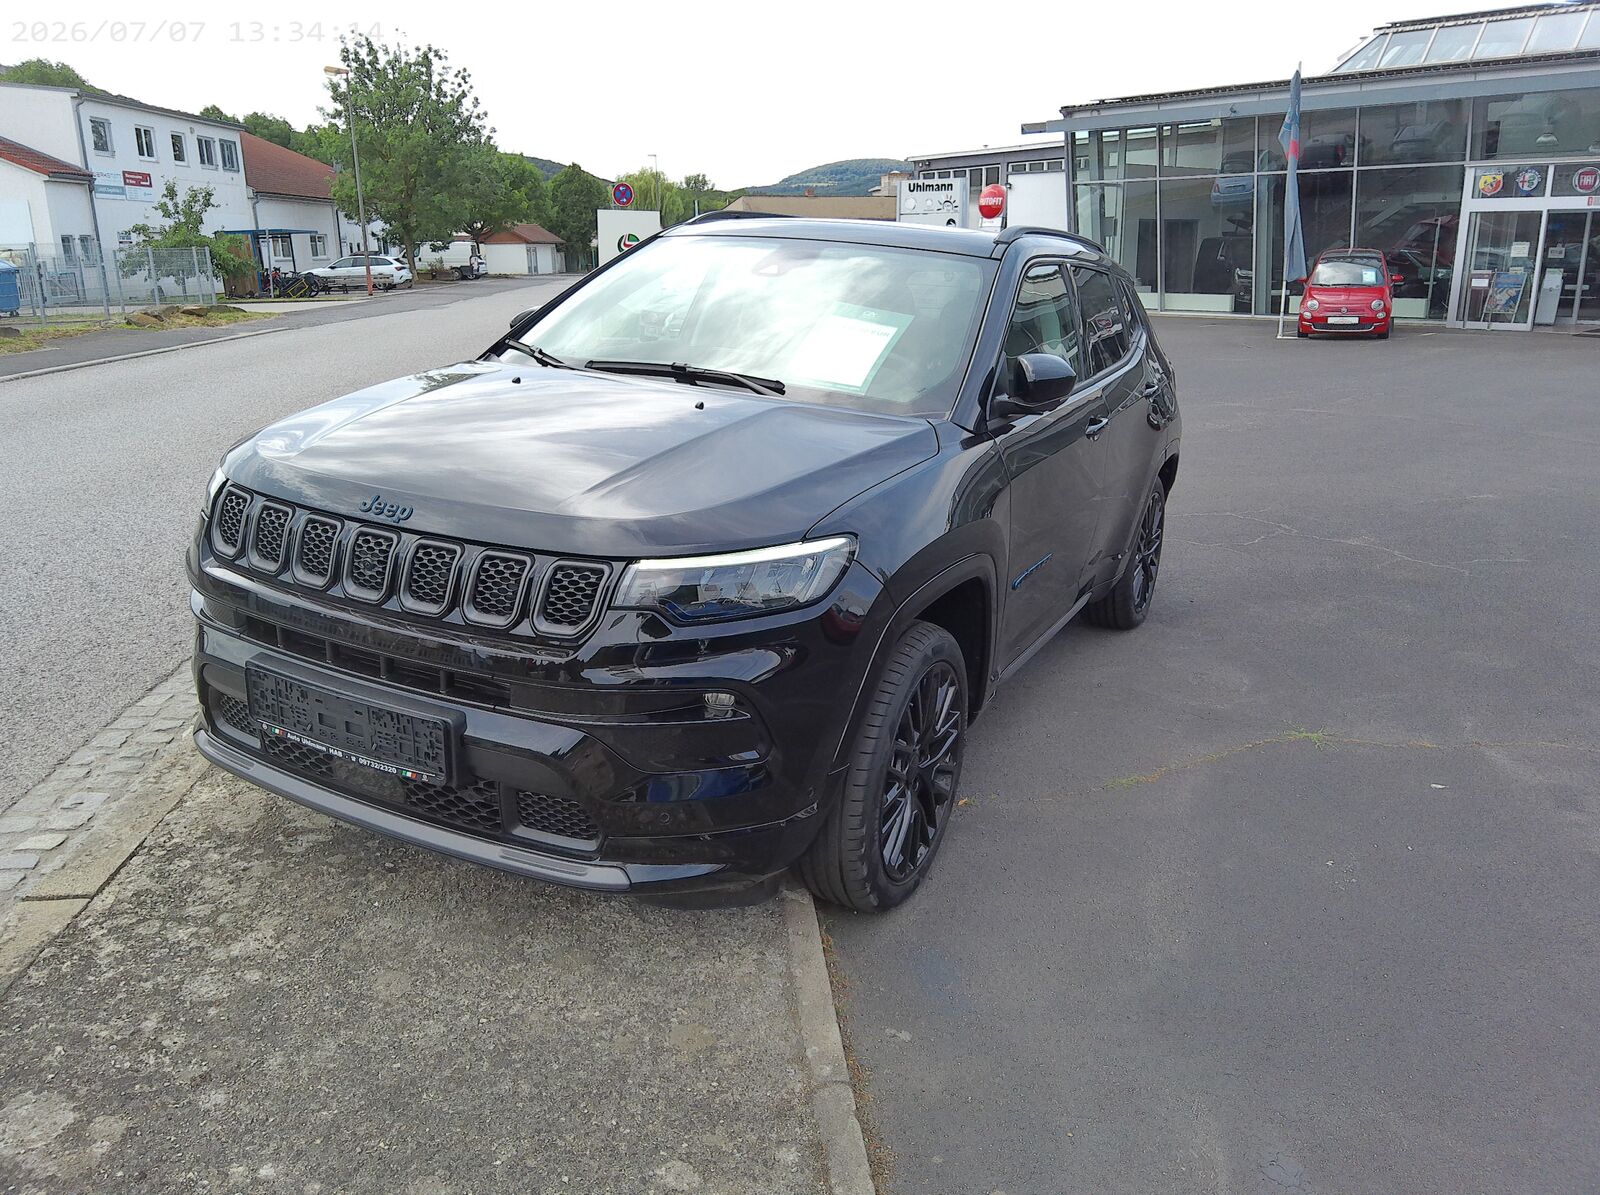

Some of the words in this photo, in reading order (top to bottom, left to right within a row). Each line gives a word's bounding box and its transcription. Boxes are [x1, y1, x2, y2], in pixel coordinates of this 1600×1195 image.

[908, 182, 954, 192] Uhlmann
[1579, 175, 1596, 186] FIAT
[359, 495, 414, 523] Jeep
[287, 732, 301, 742] Auto
[301, 737, 327, 752] Uhlmann
